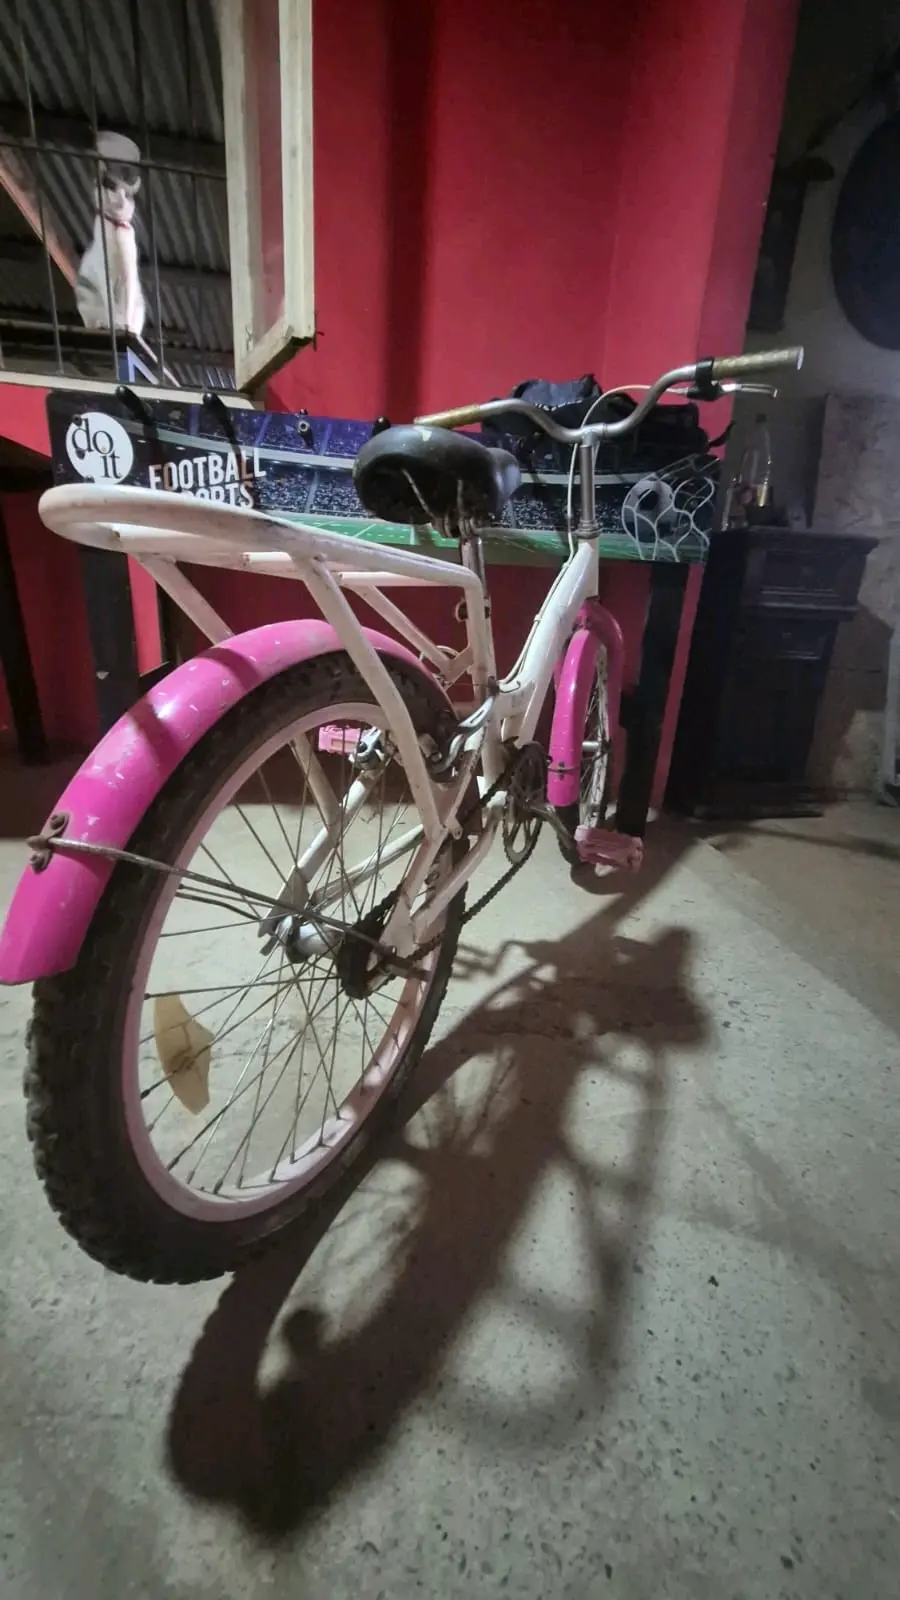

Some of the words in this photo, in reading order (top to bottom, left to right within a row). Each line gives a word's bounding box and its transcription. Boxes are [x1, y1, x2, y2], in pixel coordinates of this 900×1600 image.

[71, 417, 114, 455] do
[100, 450, 122, 479] it
[148, 447, 267, 491] FOOTBALL
